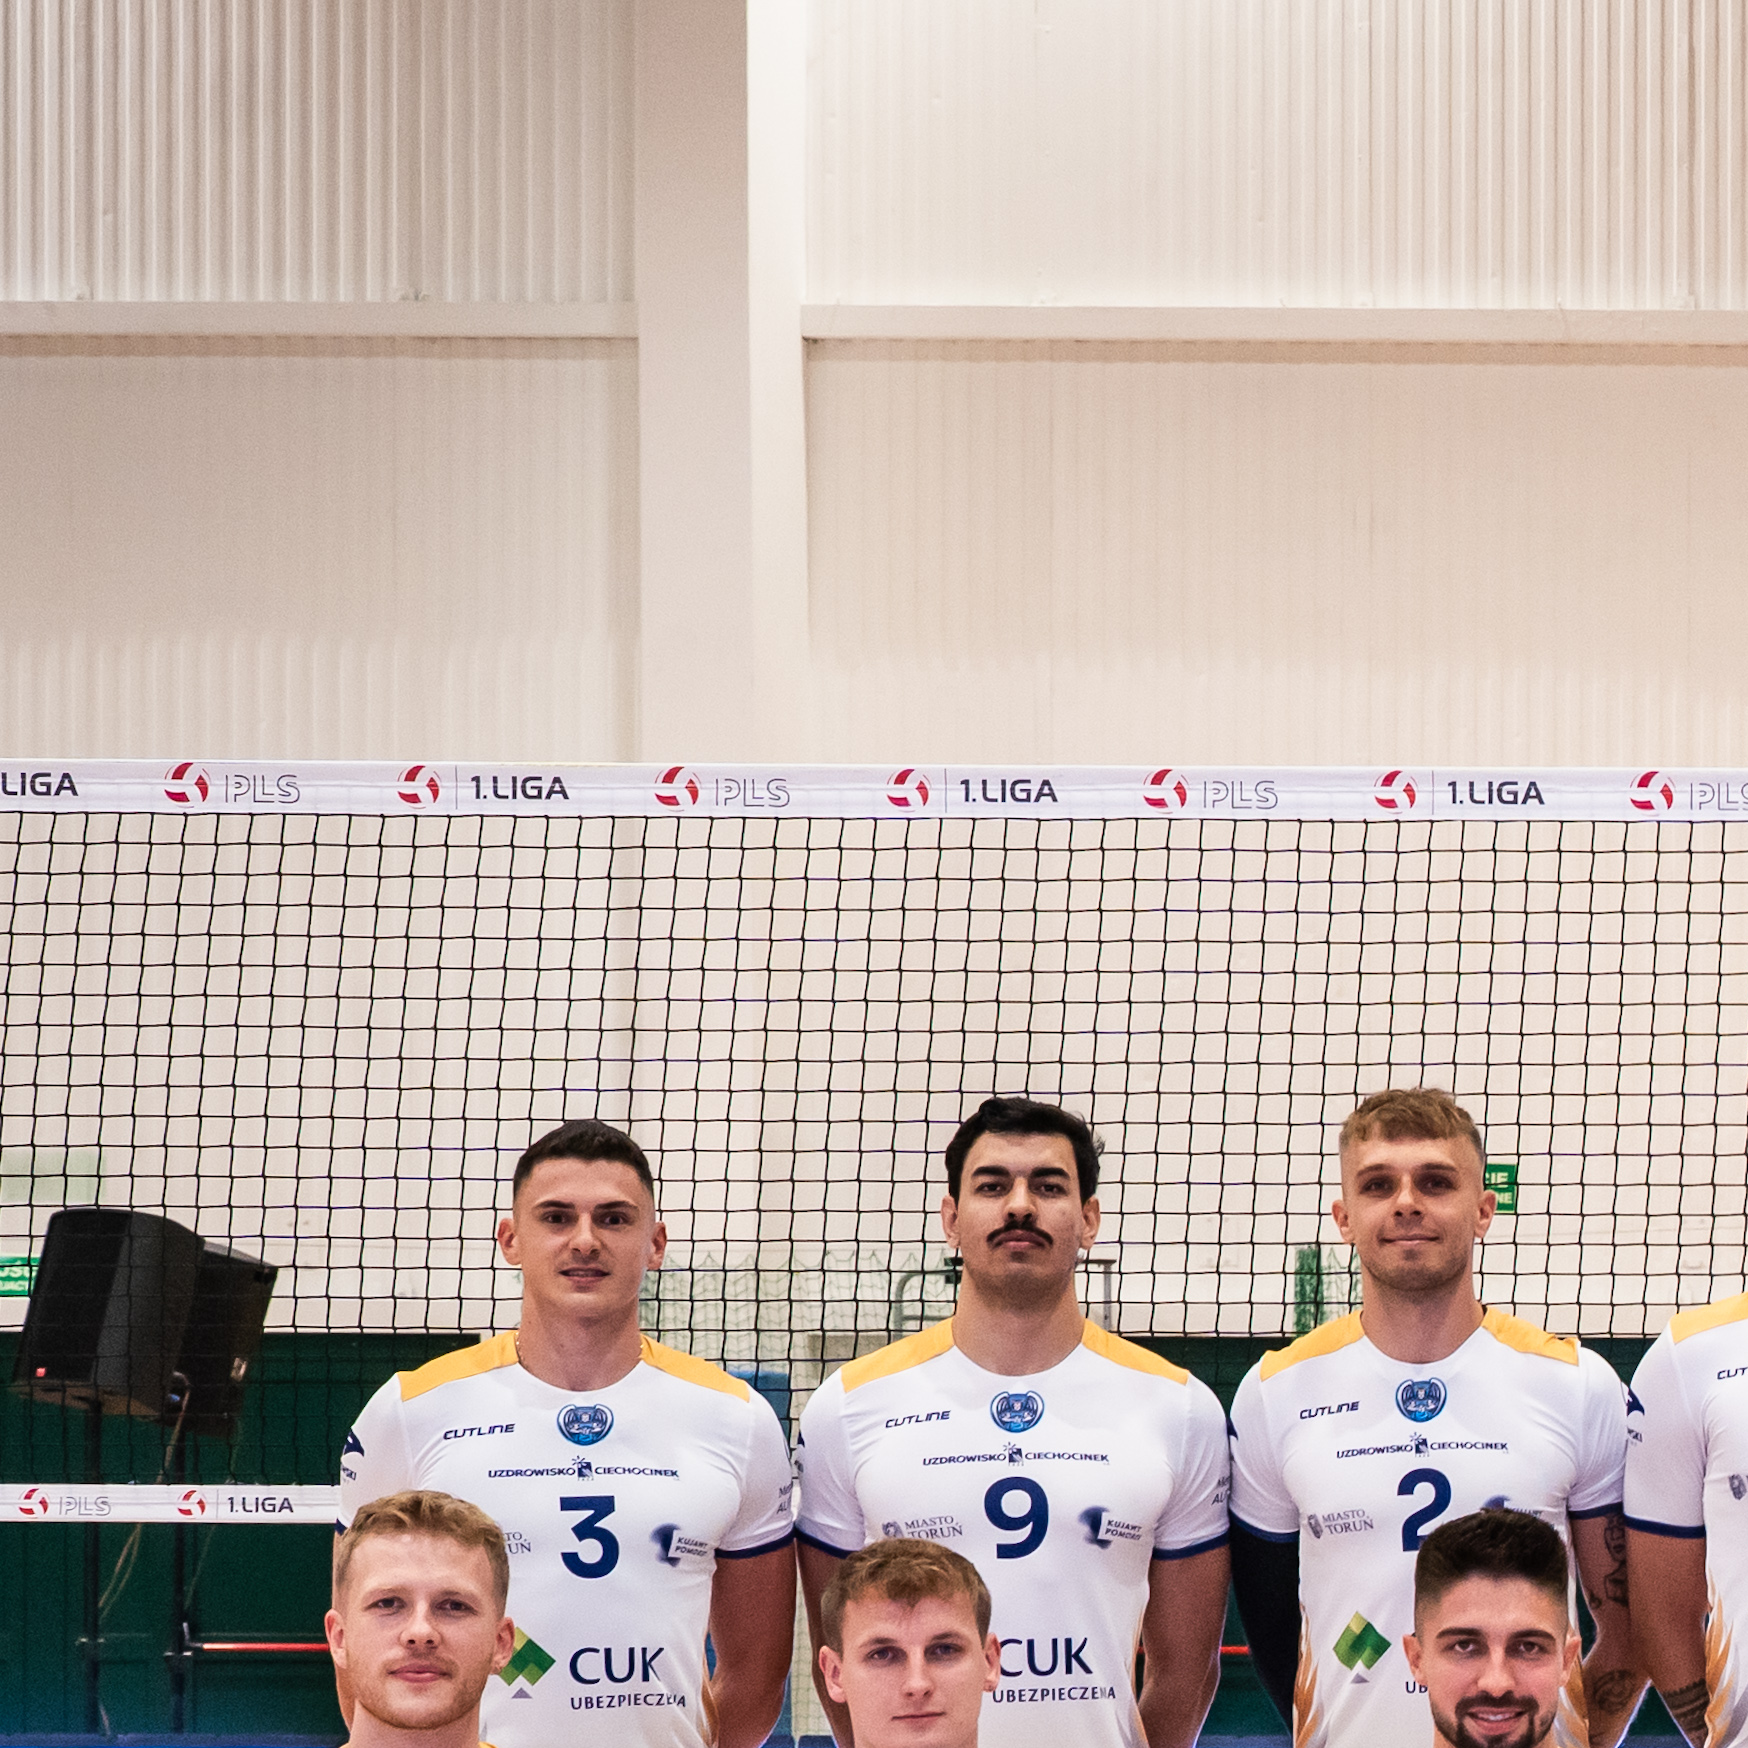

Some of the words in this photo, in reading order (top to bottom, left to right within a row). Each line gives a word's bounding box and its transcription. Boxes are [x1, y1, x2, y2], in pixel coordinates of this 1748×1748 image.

[885, 1410, 951, 1428] CUTLINE
[1299, 1401, 1361, 1420] CUTLINE
[443, 1424, 516, 1441] CUTLINE
[922, 1450, 1007, 1467] UZDROWISKO
[1024, 1450, 1110, 1464] CIECHOCINEK
[1336, 1443, 1414, 1459] UZDROWISKO
[1430, 1440, 1509, 1453] CIECHOCINEK
[488, 1466, 576, 1480] UZDROWISKO
[595, 1465, 680, 1480] CIECHOCINEK
[227, 1497, 294, 1513] 1.LIGA
[1397, 1467, 1453, 1552] 2
[904, 1515, 955, 1530] MIASTO
[984, 1476, 1049, 1560] 9
[1322, 1509, 1367, 1522] MIASTO
[560, 1495, 619, 1579] 3
[569, 1647, 664, 1685] CUK
[999, 1637, 1093, 1678] CUK
